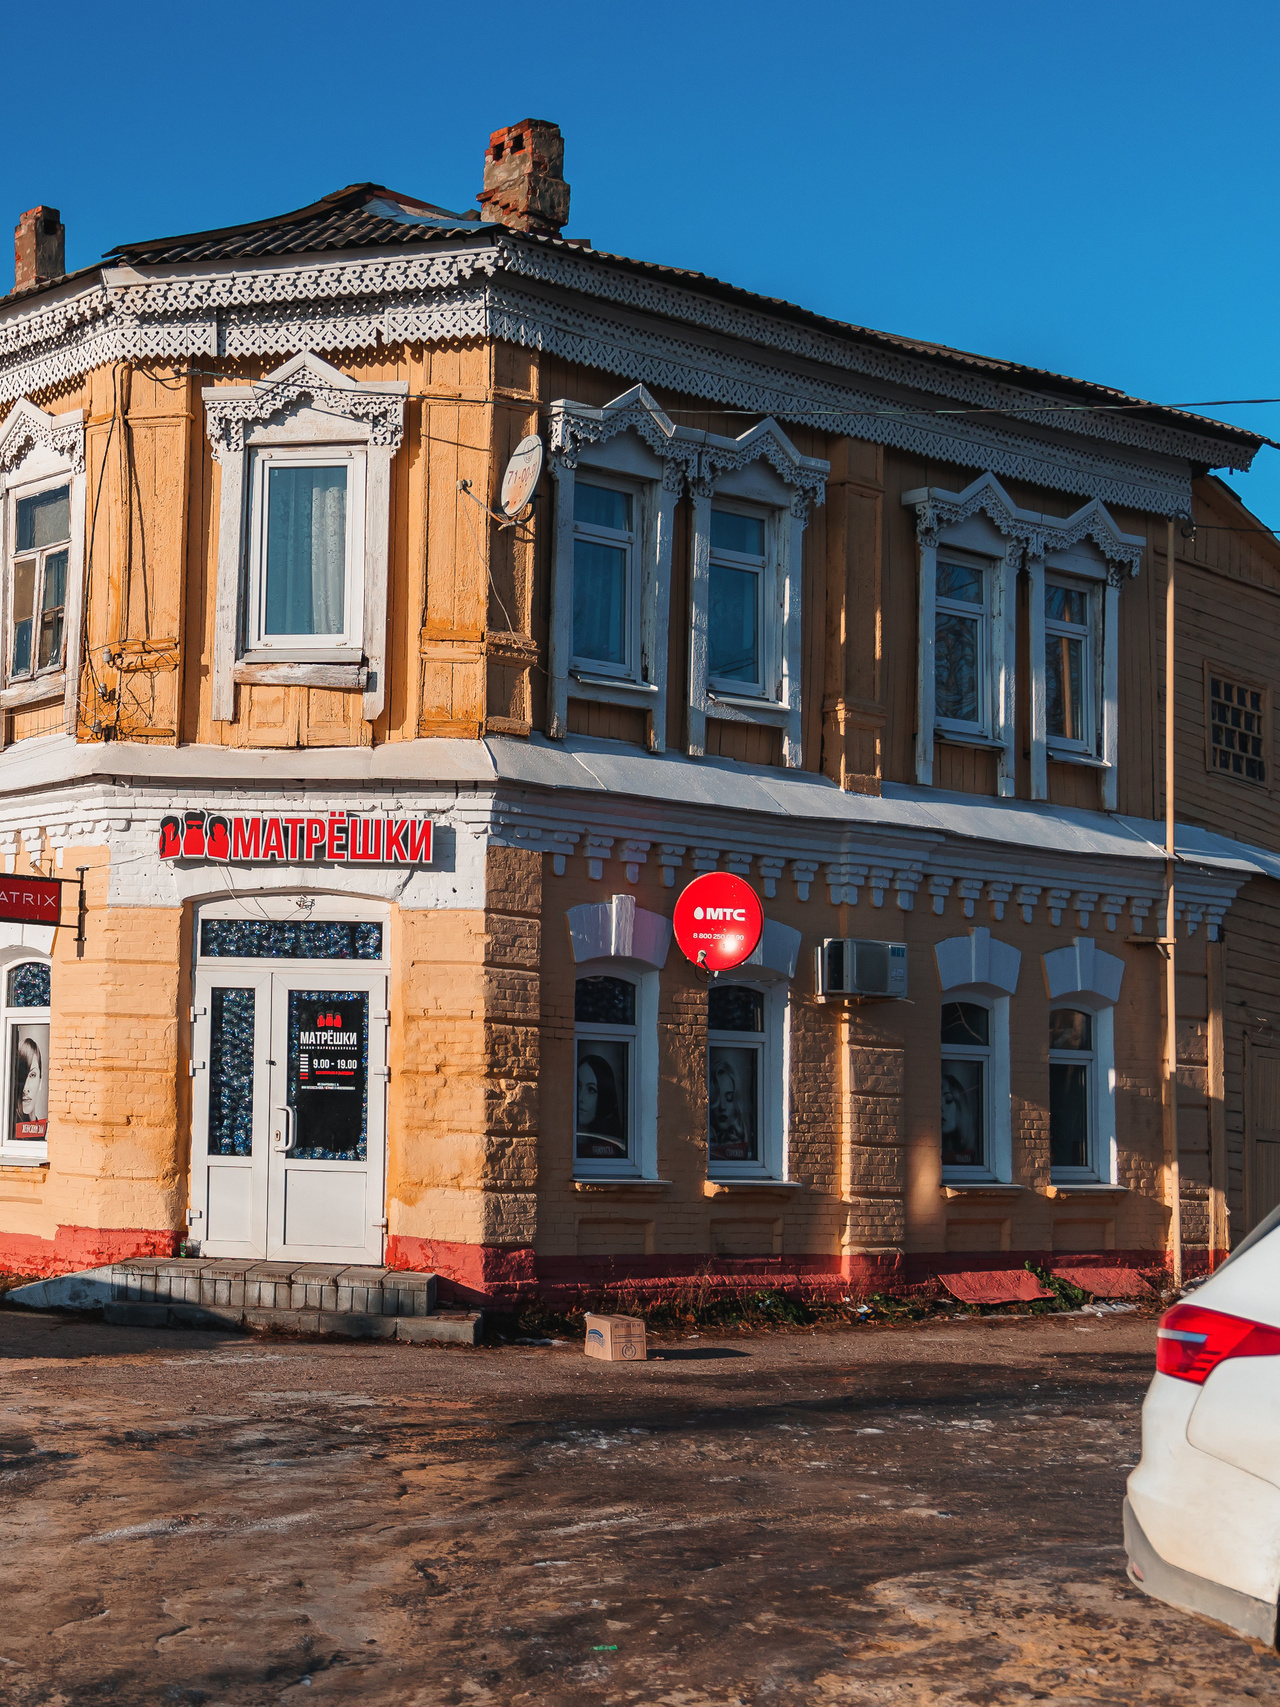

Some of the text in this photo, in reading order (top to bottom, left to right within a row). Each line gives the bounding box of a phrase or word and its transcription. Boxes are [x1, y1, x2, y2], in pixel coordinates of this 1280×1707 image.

[232, 811, 433, 863] МАТРЁШКИ
[706, 907, 745, 921] МТС
[300, 1030, 357, 1045] МАТРЁШКИ
[313, 1059, 330, 1069] 9.00
[337, 1059, 357, 1069] 19.00
